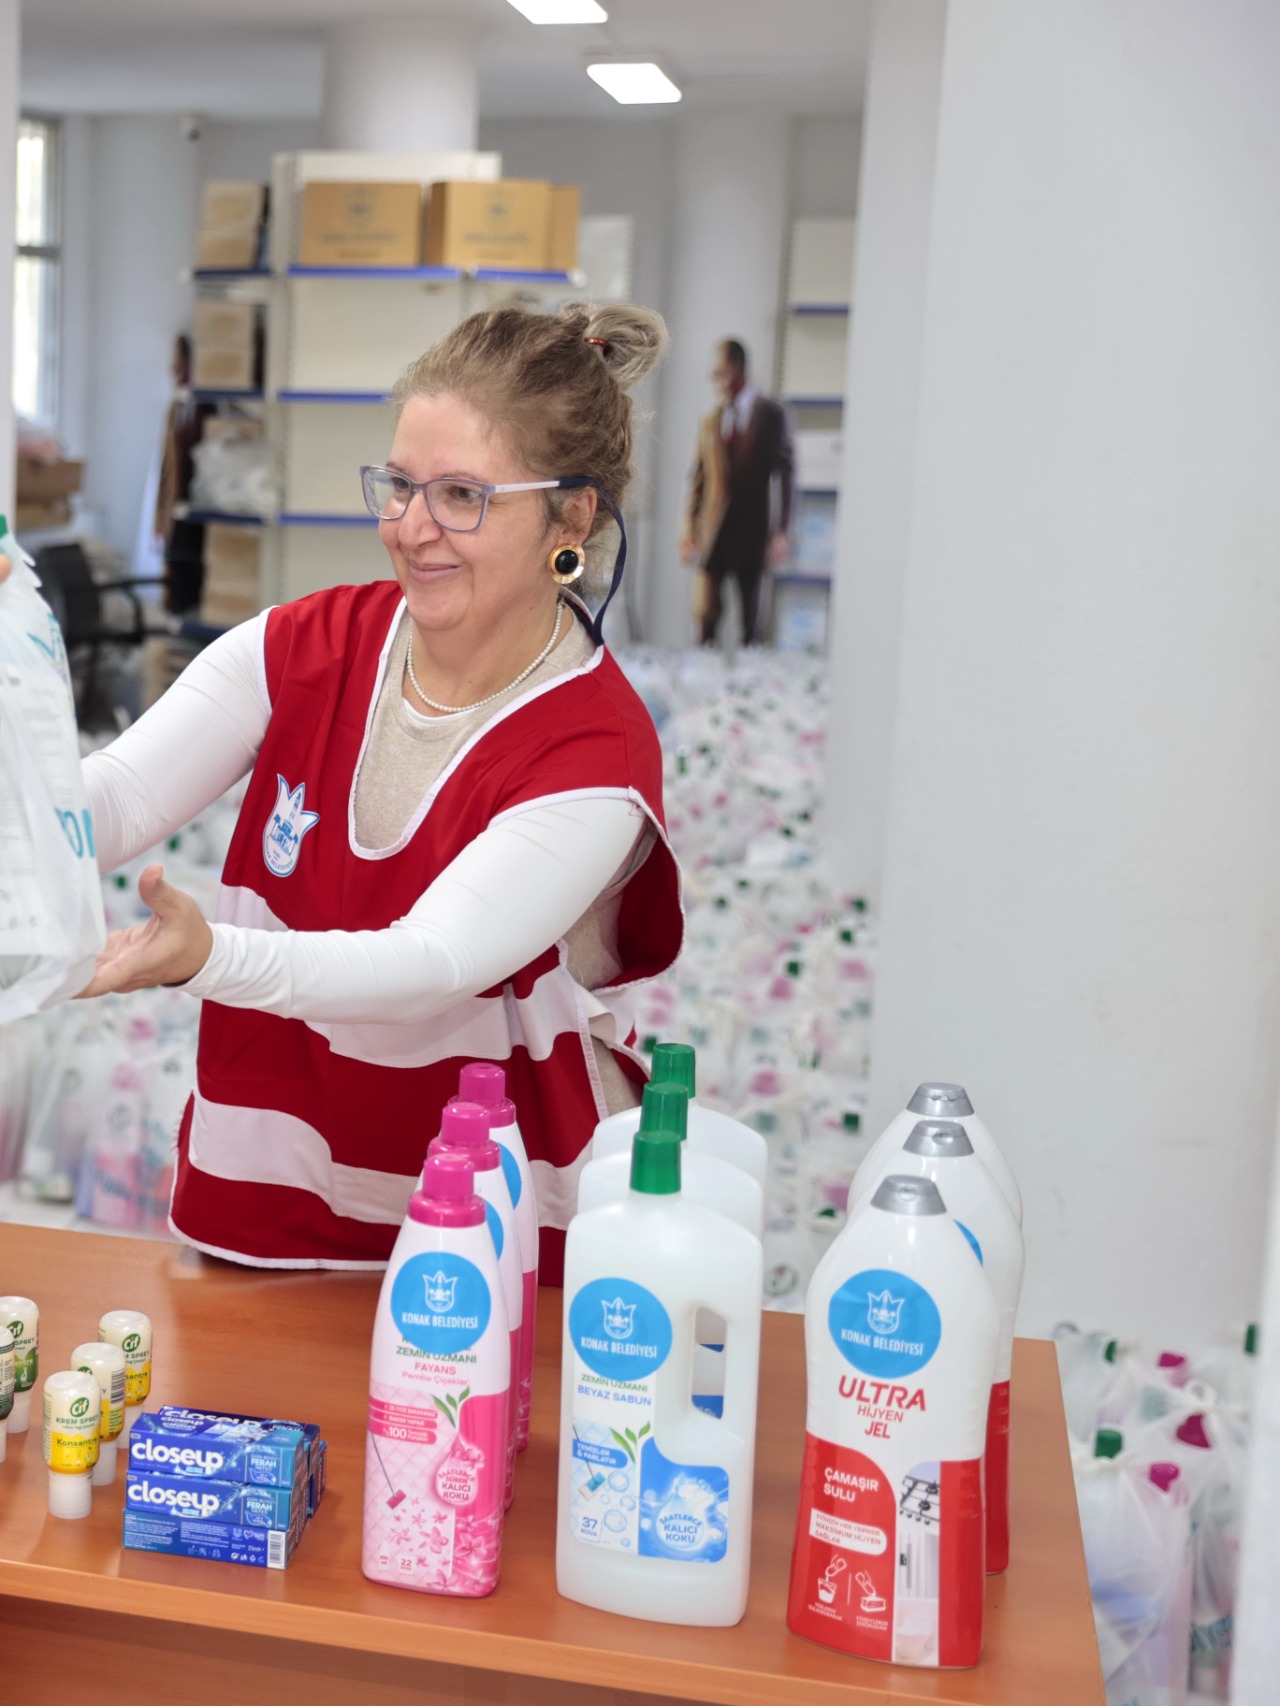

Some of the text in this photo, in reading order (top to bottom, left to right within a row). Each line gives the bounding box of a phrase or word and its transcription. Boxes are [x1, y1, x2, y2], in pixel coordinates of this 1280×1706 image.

[402, 1312, 479, 1329] KONAK BELEDİYESİ
[123, 1335, 140, 1351] Cif
[581, 1335, 658, 1359] KONAK BELEDİYESİ
[841, 1328, 924, 1356] KONAK BELEDİYESİ
[396, 1345, 430, 1359] ZEMİN
[414, 1361, 457, 1375] FAYANS
[402, 1370, 469, 1387] Pembe Çiçekler
[581, 1373, 609, 1387] ZEMİN
[577, 1384, 652, 1406] BEYAZ SABUN
[838, 1374, 927, 1412] ULTRA
[71, 1399, 88, 1416] Cif
[857, 1404, 904, 1423] HİJYEN
[56, 1417, 78, 1425] KREM
[864, 1421, 891, 1439] JEL
[56, 1438, 98, 1448] Konsantre
[577, 1441, 611, 1456] TEMİZLER
[131, 1438, 224, 1475] closeup
[250, 1458, 277, 1468] FERAH
[441, 1482, 471, 1492] KALICI
[824, 1467, 879, 1492] ÇAMAŞIR
[127, 1480, 220, 1517] closeup
[443, 1490, 469, 1501] KOKU
[823, 1484, 856, 1503] SULU
[246, 1501, 273, 1511] FERAH
[582, 1516, 598, 1530] 37
[659, 1513, 703, 1528] SAATLERCE
[580, 1528, 598, 1537] KOVA
[663, 1523, 698, 1534] KALICI
[815, 1521, 881, 1545] MAKSİMUM HİJYEN
[665, 1532, 696, 1543] KOKU
